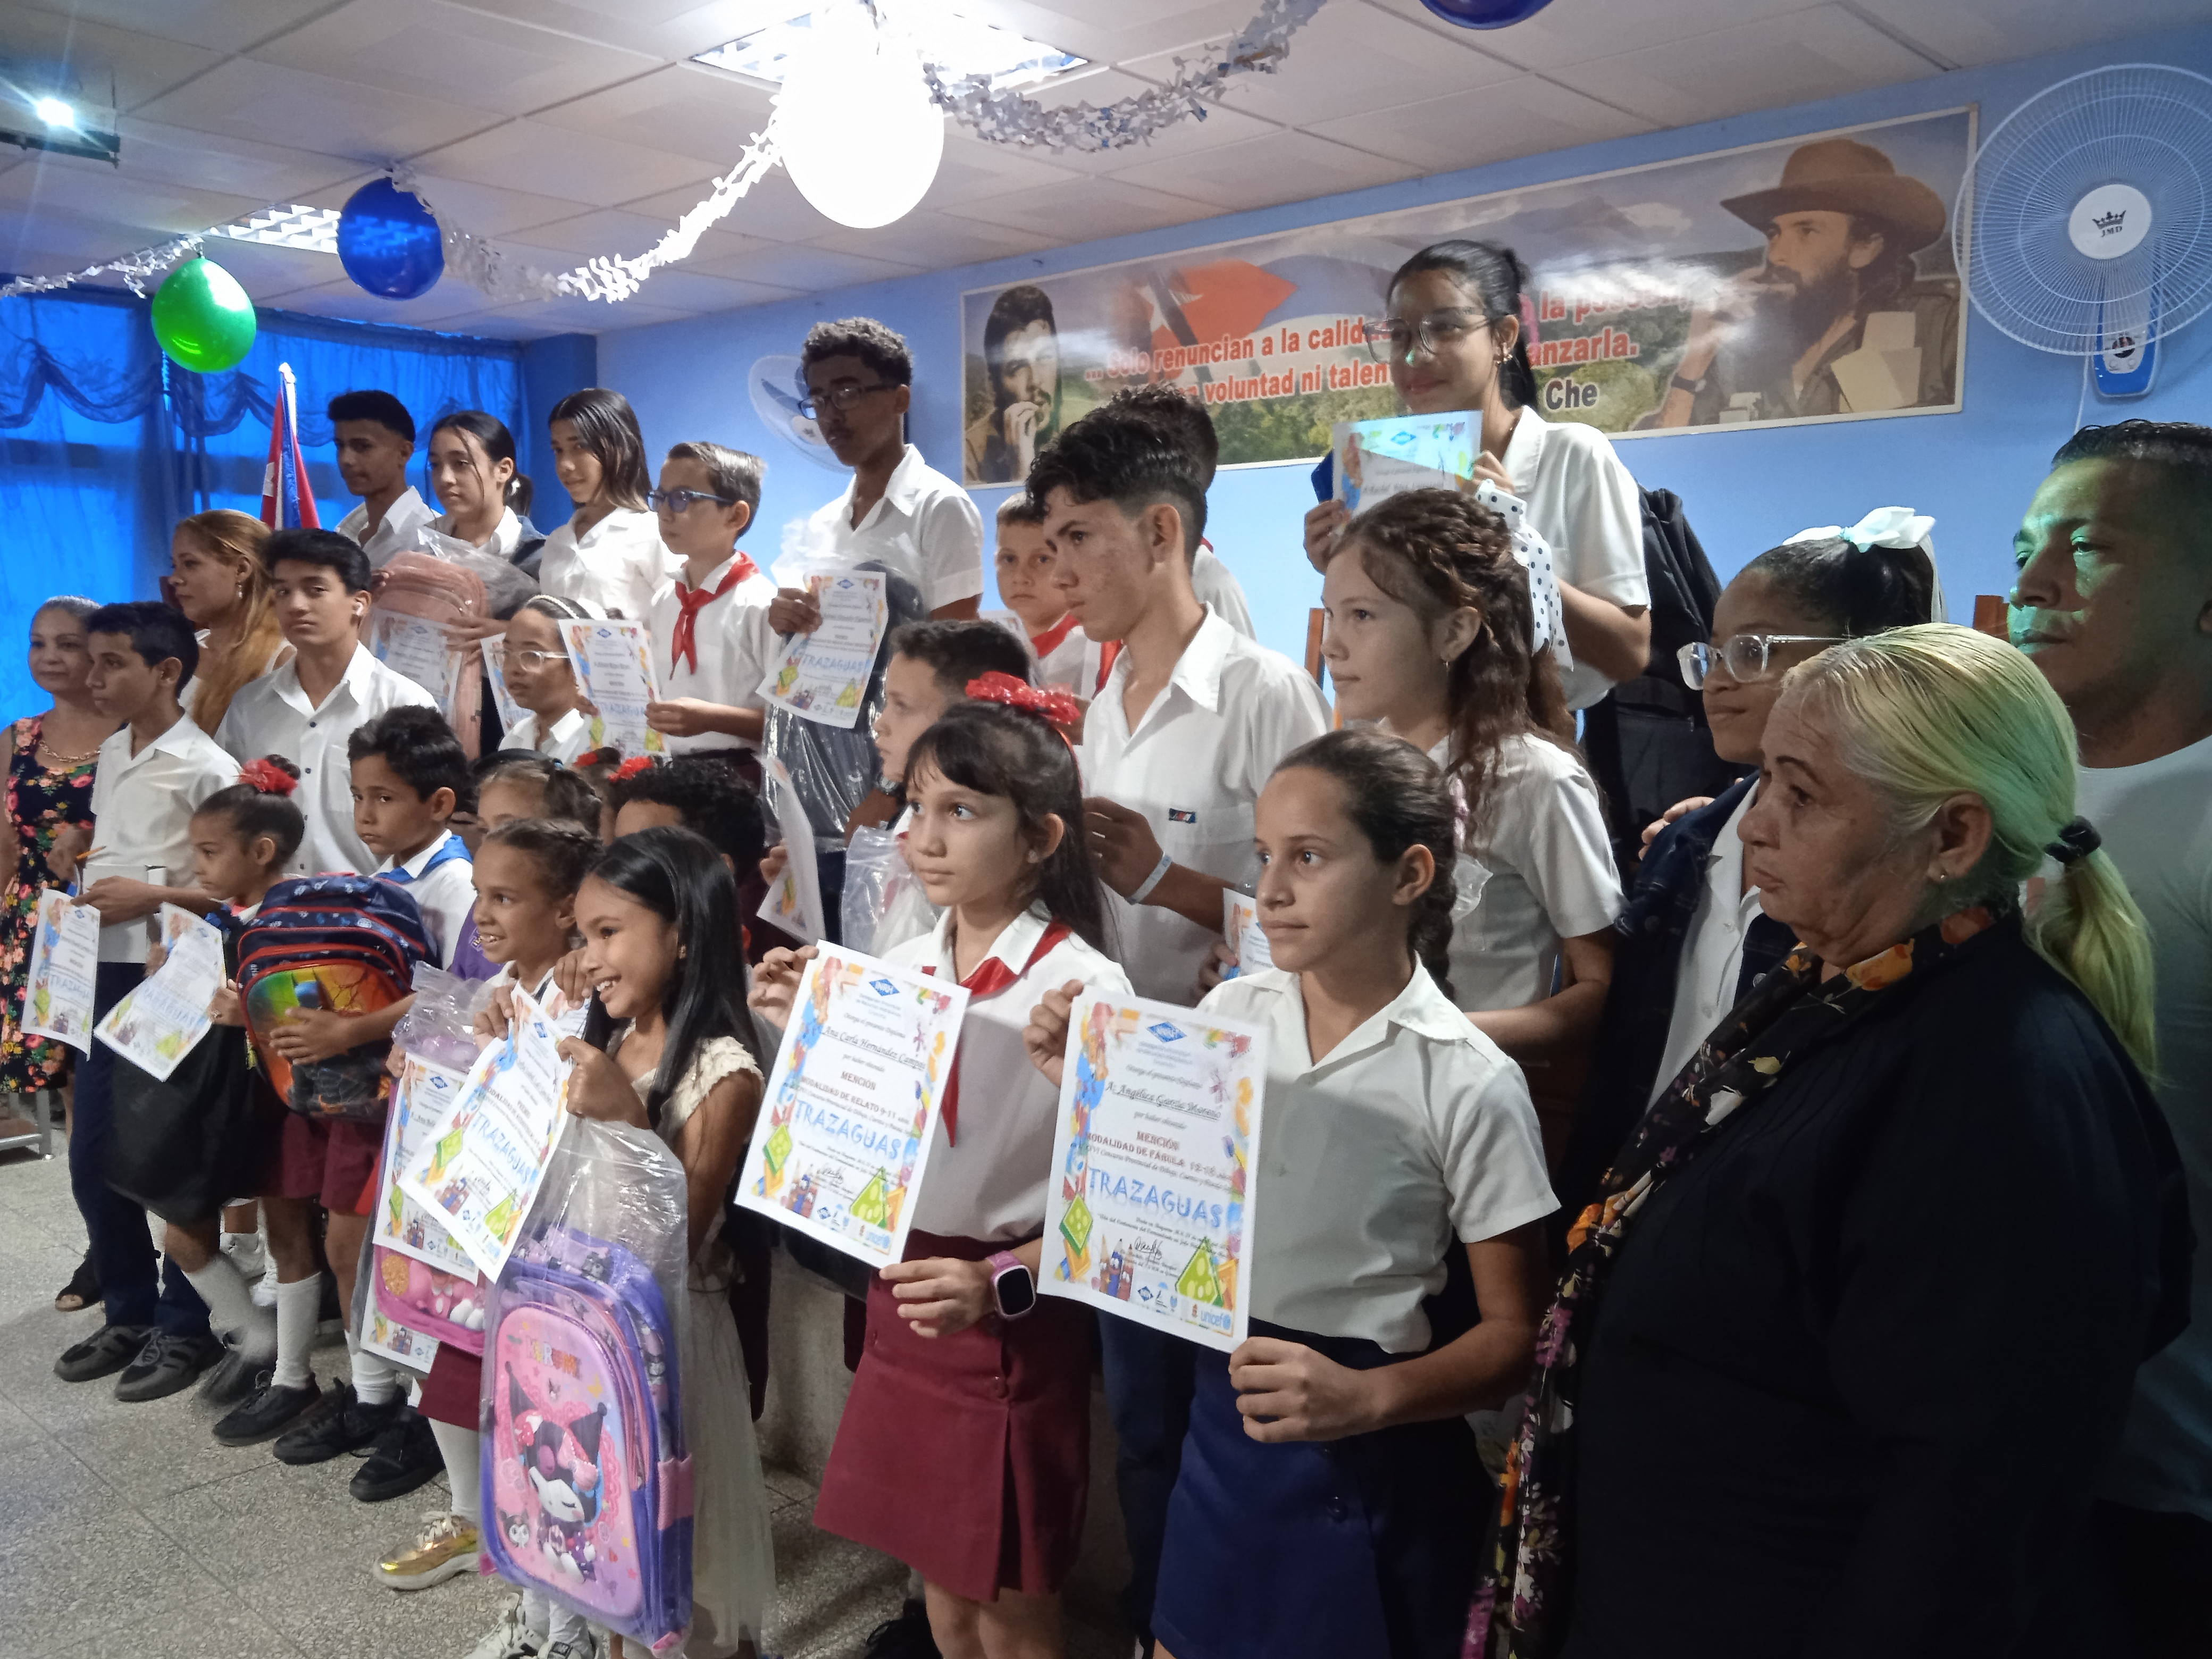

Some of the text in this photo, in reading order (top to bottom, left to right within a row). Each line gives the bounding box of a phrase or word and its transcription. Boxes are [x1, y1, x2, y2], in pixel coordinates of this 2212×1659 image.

[2101, 225, 2123, 238] JMD
[1155, 333, 1255, 372] renuncian
[1261, 336, 1273, 357] a
[1281, 328, 1300, 354] la
[1541, 291, 1565, 320] la
[1205, 365, 1294, 404] voluntad
[1302, 364, 1321, 392] ni
[1329, 358, 1389, 389] talen
[1545, 379, 1598, 410] Che
[824, 1026, 839, 1037] Ana
[840, 1070, 877, 1091] MENCIÓN
[840, 1091, 850, 1101] DE
[850, 1095, 880, 1113] RELATO
[795, 1099, 902, 1160] TRAZAGUAS
[1135, 1130, 1181, 1151] MENCIÓN
[473, 1110, 531, 1185] TRAZAGUAS
[1136, 1145, 1148, 1157] DE
[1088, 1167, 1223, 1229] TRAZAGUAS
[1200, 1309, 1224, 1327] unicef
[525, 1335, 582, 1381] KUROMI
